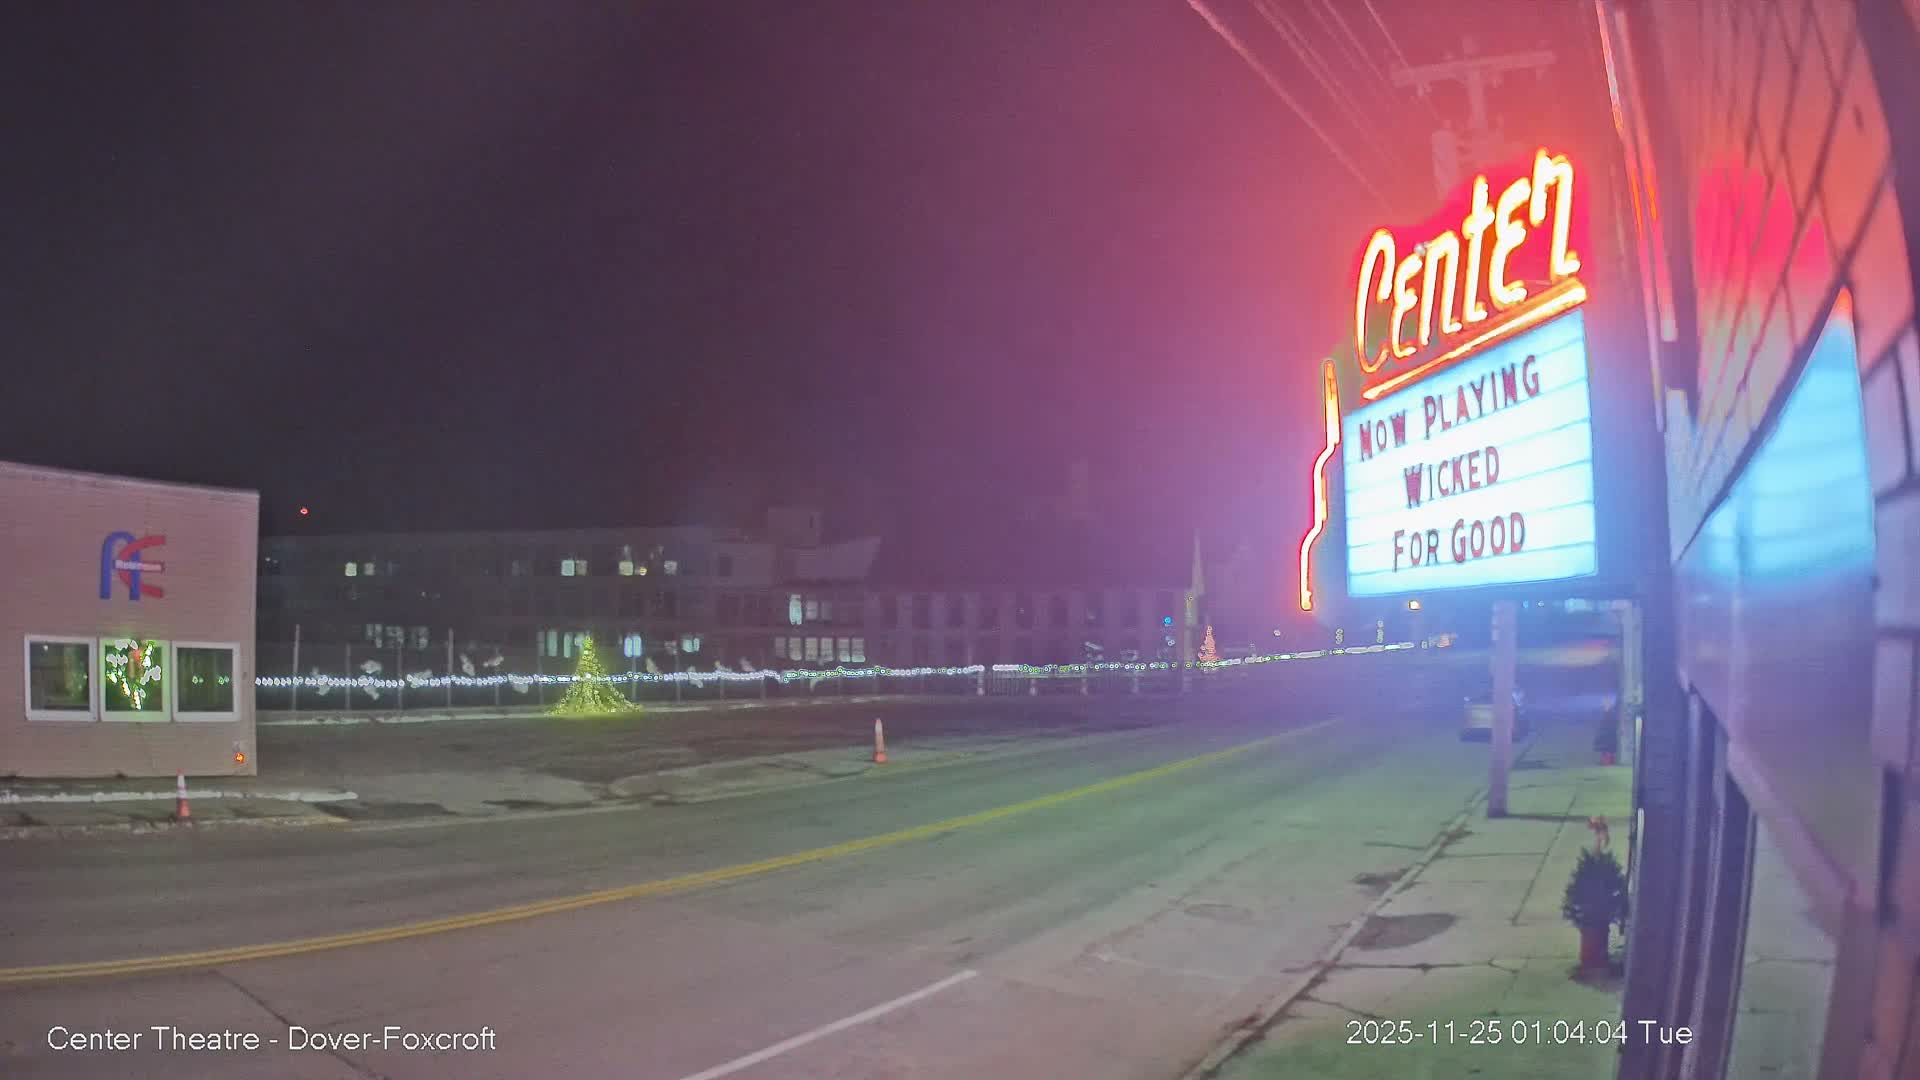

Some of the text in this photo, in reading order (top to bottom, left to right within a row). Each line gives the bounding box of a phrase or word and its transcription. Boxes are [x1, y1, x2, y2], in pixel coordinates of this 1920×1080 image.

[1423, 354, 1541, 440] PLAYING
[1403, 446, 1500, 509] WICKED
[1392, 511, 1527, 573] FOR GOOD
